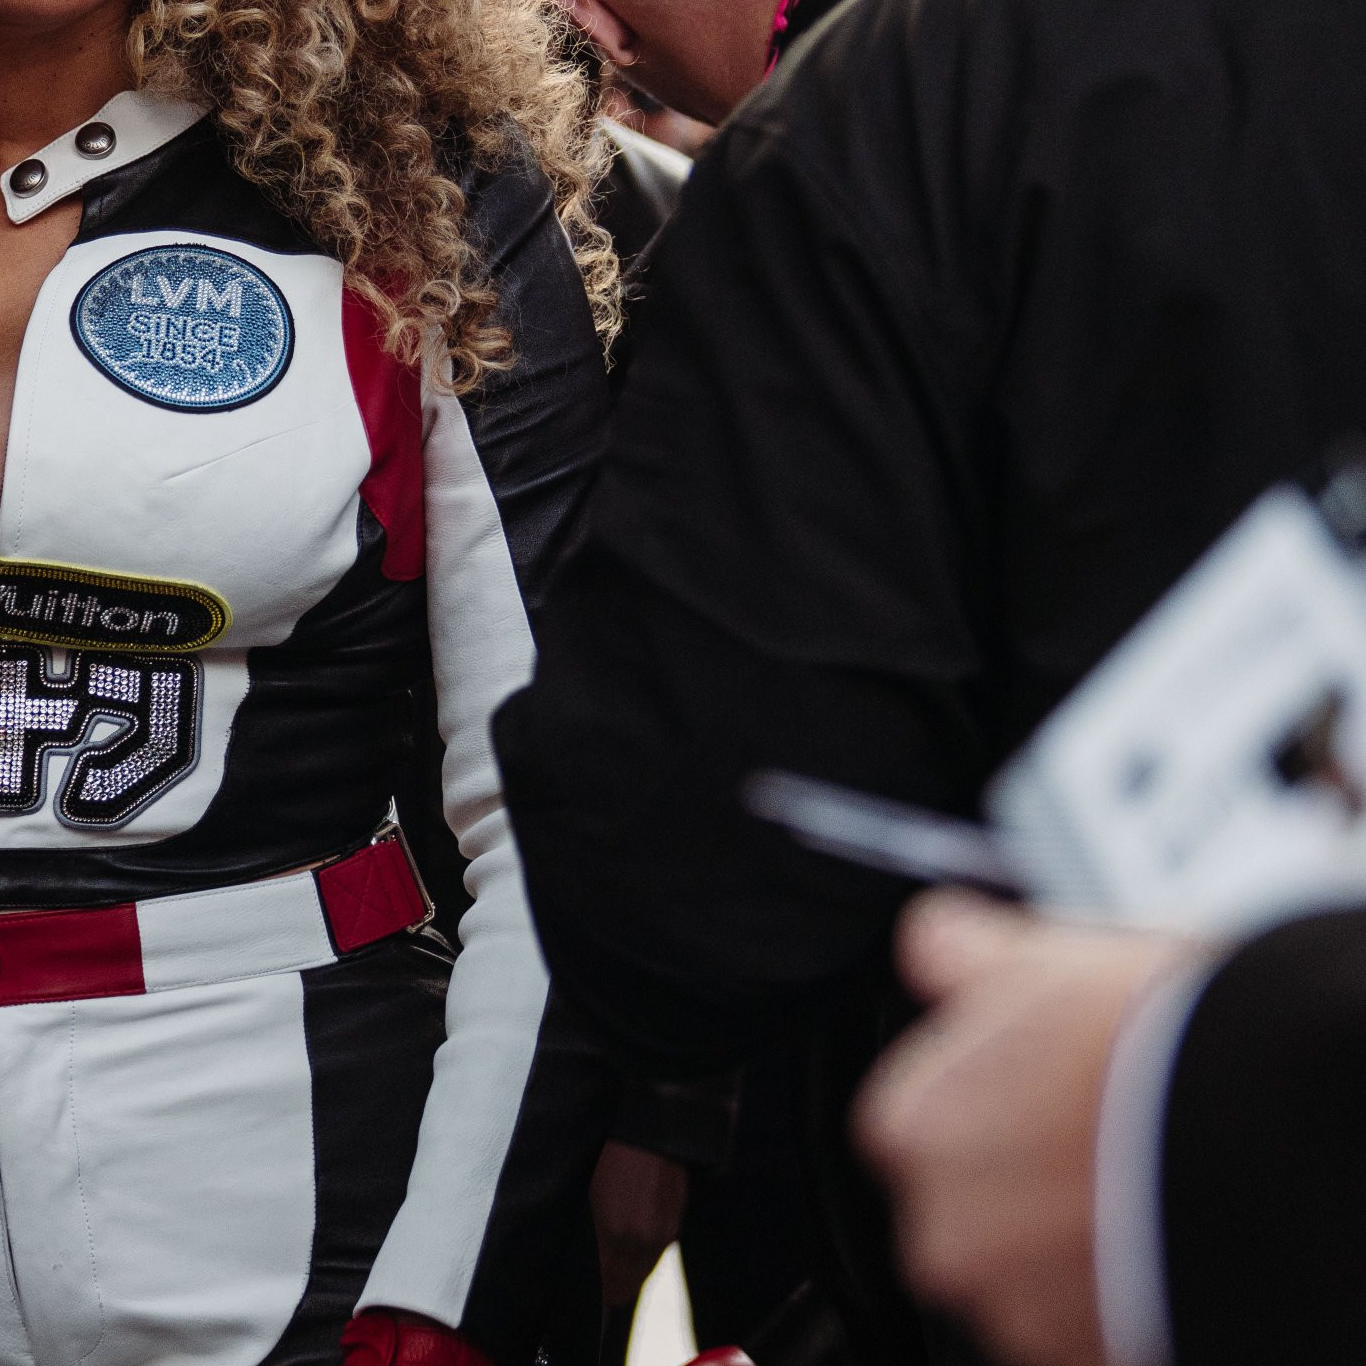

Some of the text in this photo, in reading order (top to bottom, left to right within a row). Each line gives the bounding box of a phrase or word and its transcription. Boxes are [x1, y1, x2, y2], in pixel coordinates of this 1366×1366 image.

[130, 274, 243, 319] LVM
[130, 312, 238, 349] SINCE
[141, 338, 221, 371] 1854
